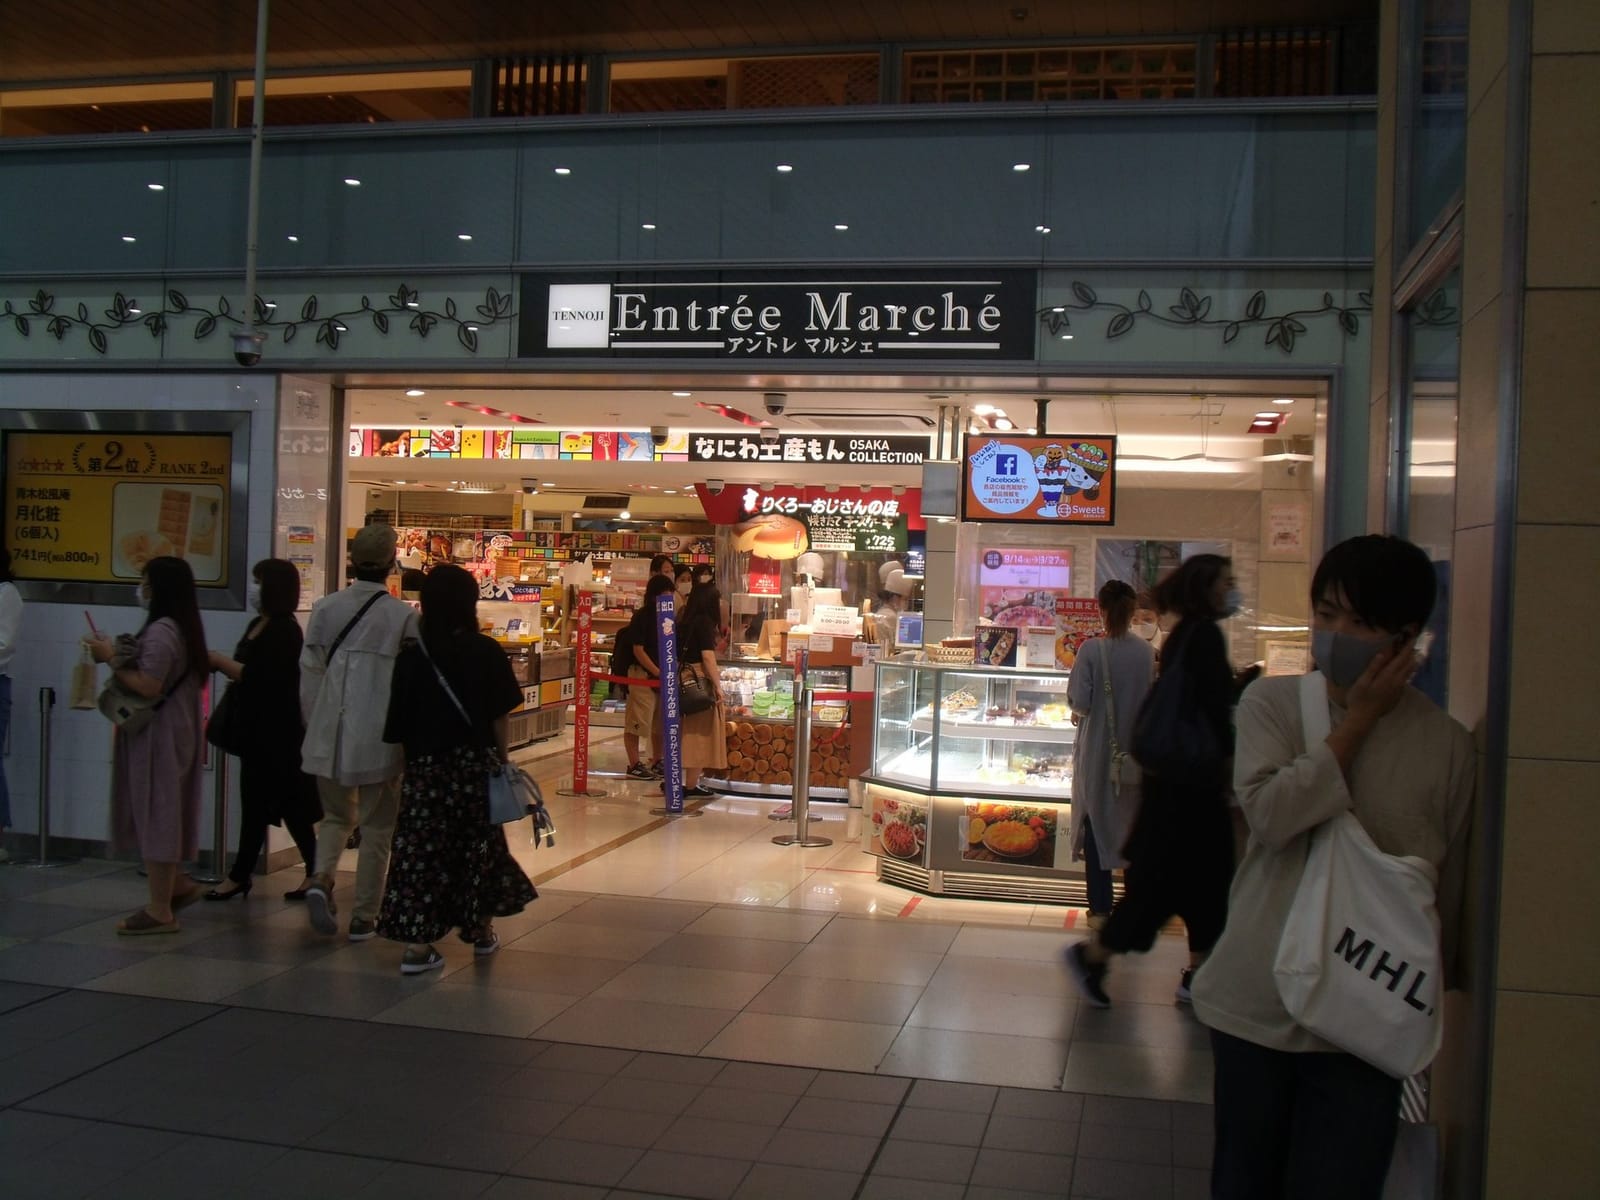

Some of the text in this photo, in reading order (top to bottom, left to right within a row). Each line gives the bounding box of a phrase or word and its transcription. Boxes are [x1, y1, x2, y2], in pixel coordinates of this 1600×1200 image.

[551, 310, 605, 322] TENNOJI
[613, 291, 1002, 332] Entrée Marché
[727, 337, 874, 354] アントレ マルシェ
[849, 439, 889, 451] OSAKA
[849, 452, 923, 463] COLLECTION
[159, 461, 225, 475] RANK 2nd
[15, 506, 61, 522] 月化粧
[1072, 506, 1106, 515] Sweets
[15, 526, 60, 541] (6個入)
[579, 596, 592, 606] 入口
[661, 601, 674, 612] 出口
[666, 639, 677, 718] りくろーおじさんの店
